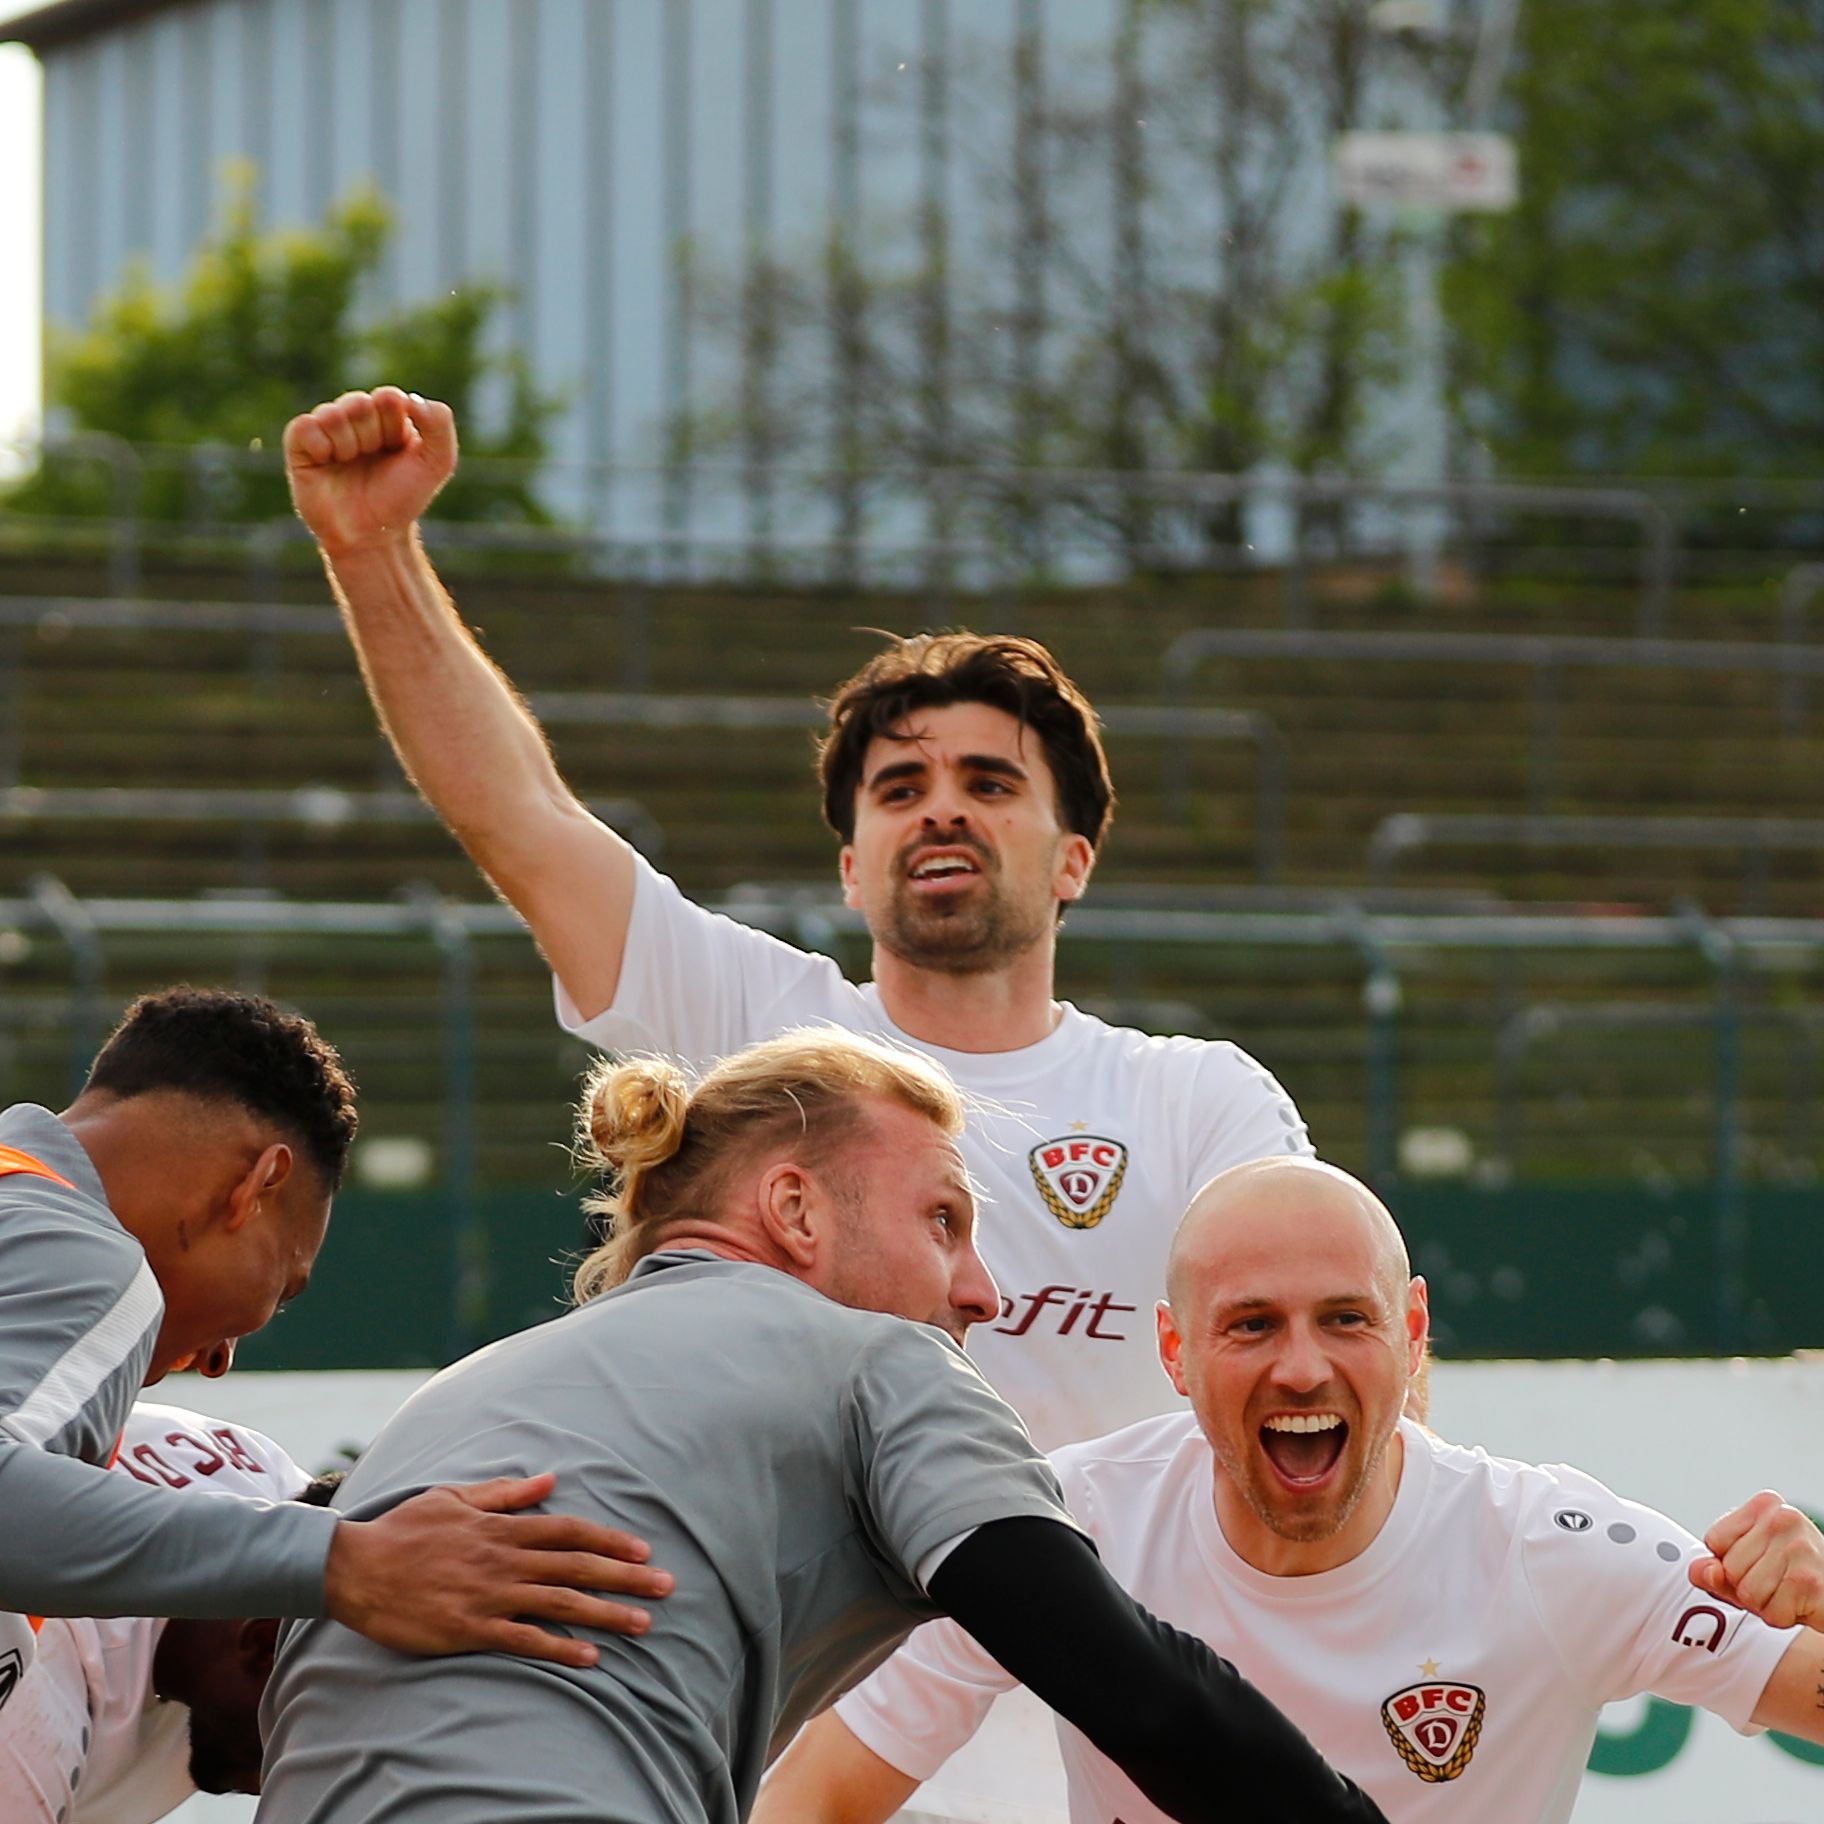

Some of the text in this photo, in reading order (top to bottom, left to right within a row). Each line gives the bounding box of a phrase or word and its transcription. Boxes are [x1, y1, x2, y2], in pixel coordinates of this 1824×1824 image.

[1042, 1142, 1116, 1169] BFC
[992, 1285, 1137, 1341] fit
[1393, 1688, 1473, 1722] BFC
